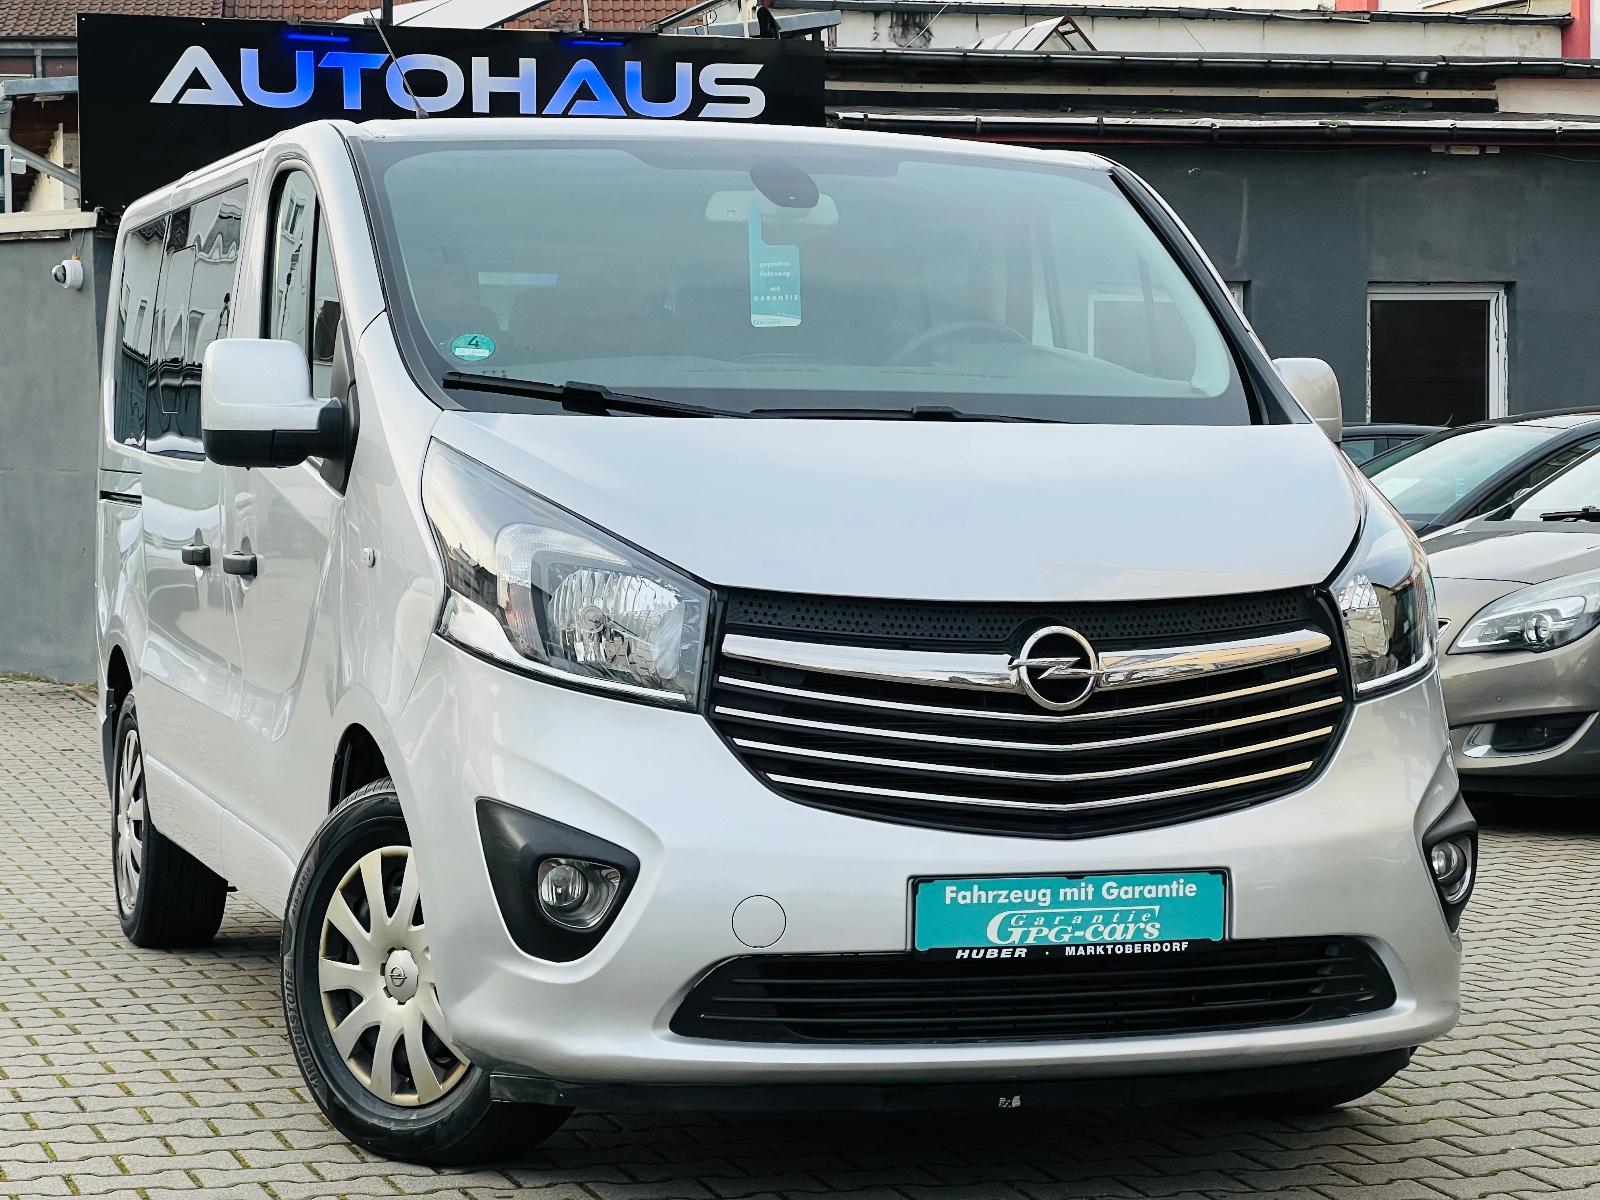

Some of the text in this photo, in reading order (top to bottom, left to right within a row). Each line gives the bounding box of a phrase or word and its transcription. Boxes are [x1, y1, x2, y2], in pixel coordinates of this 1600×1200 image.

[149, 45, 766, 118] AUTOHAUS
[467, 335, 480, 348] 4
[945, 878, 1198, 907] Fahrzeug mit Garantie
[986, 911, 1161, 945] GPG-cars
[1010, 910, 1151, 926] Garantie
[955, 941, 1189, 960] HUBER MARKTOBERDORF
